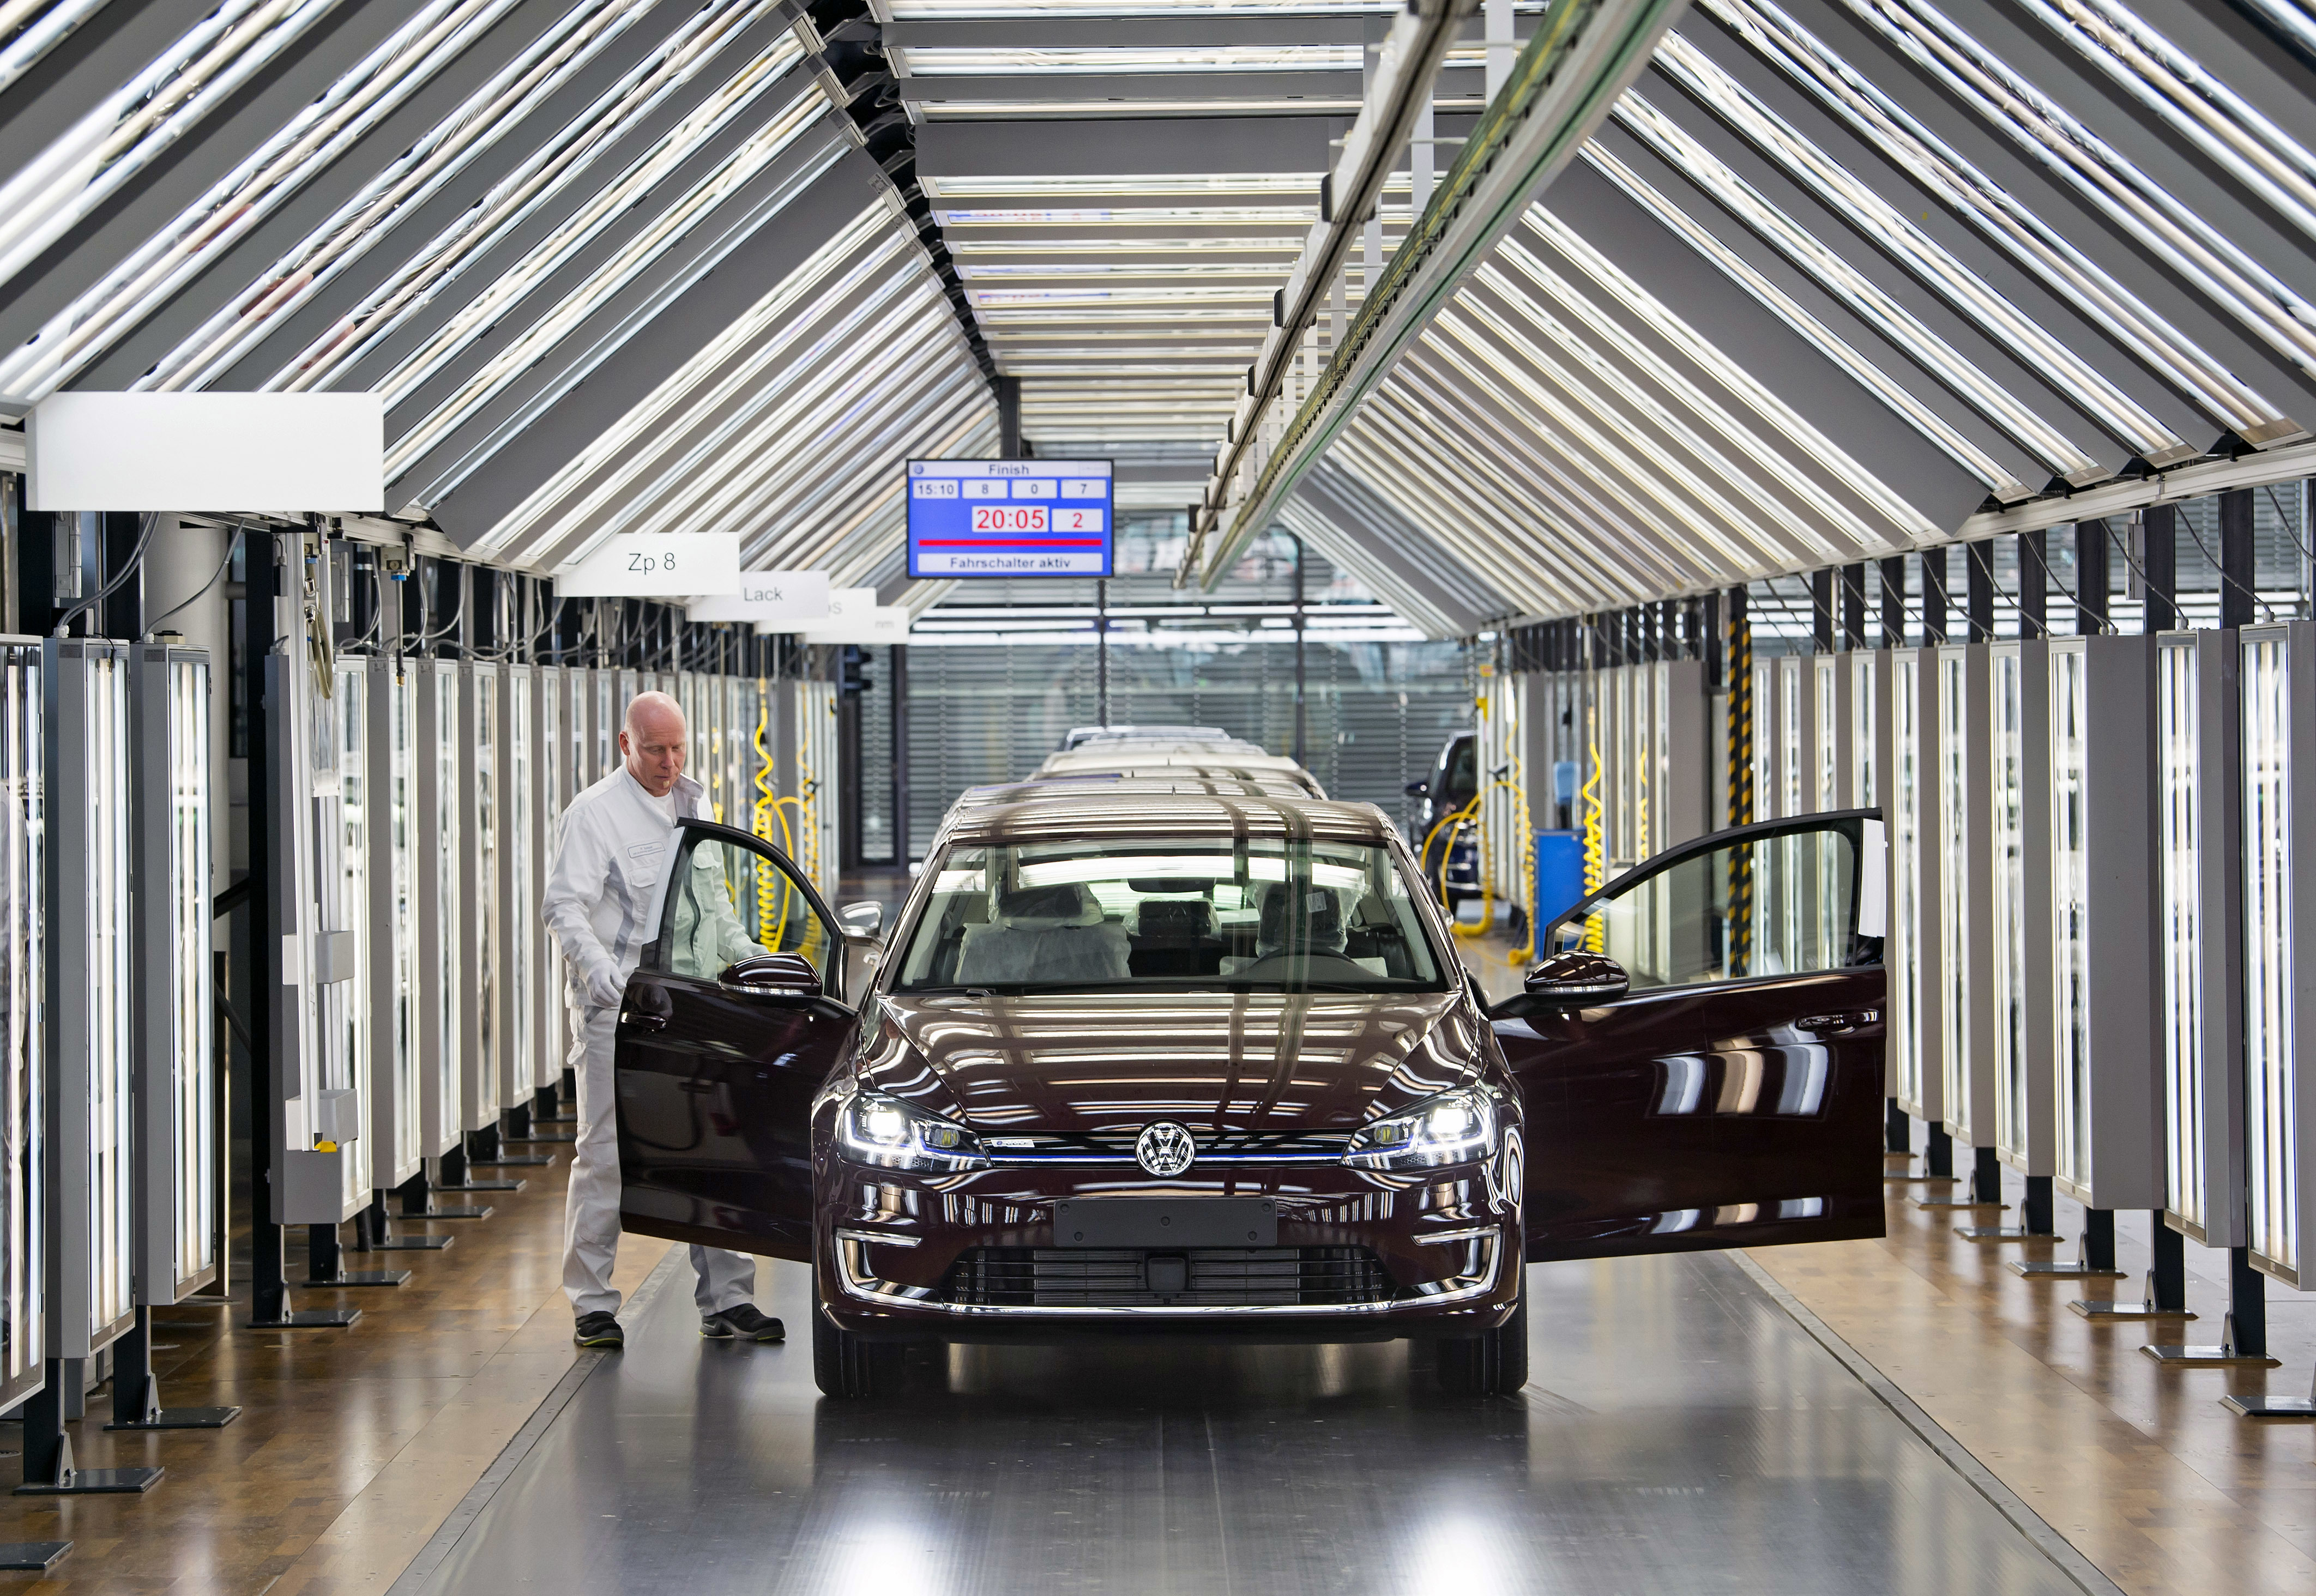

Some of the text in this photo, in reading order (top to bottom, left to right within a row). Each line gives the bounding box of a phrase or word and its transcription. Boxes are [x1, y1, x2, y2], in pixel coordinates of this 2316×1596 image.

[988, 464, 1029, 475] Finish
[919, 483, 1087, 495] 15:10 8 0 7
[977, 509, 1083, 529] 20:05 2
[628, 552, 676, 575] Zp 8
[950, 557, 1071, 569] Fahrschalter aktiv
[744, 587, 783, 602] Lack
